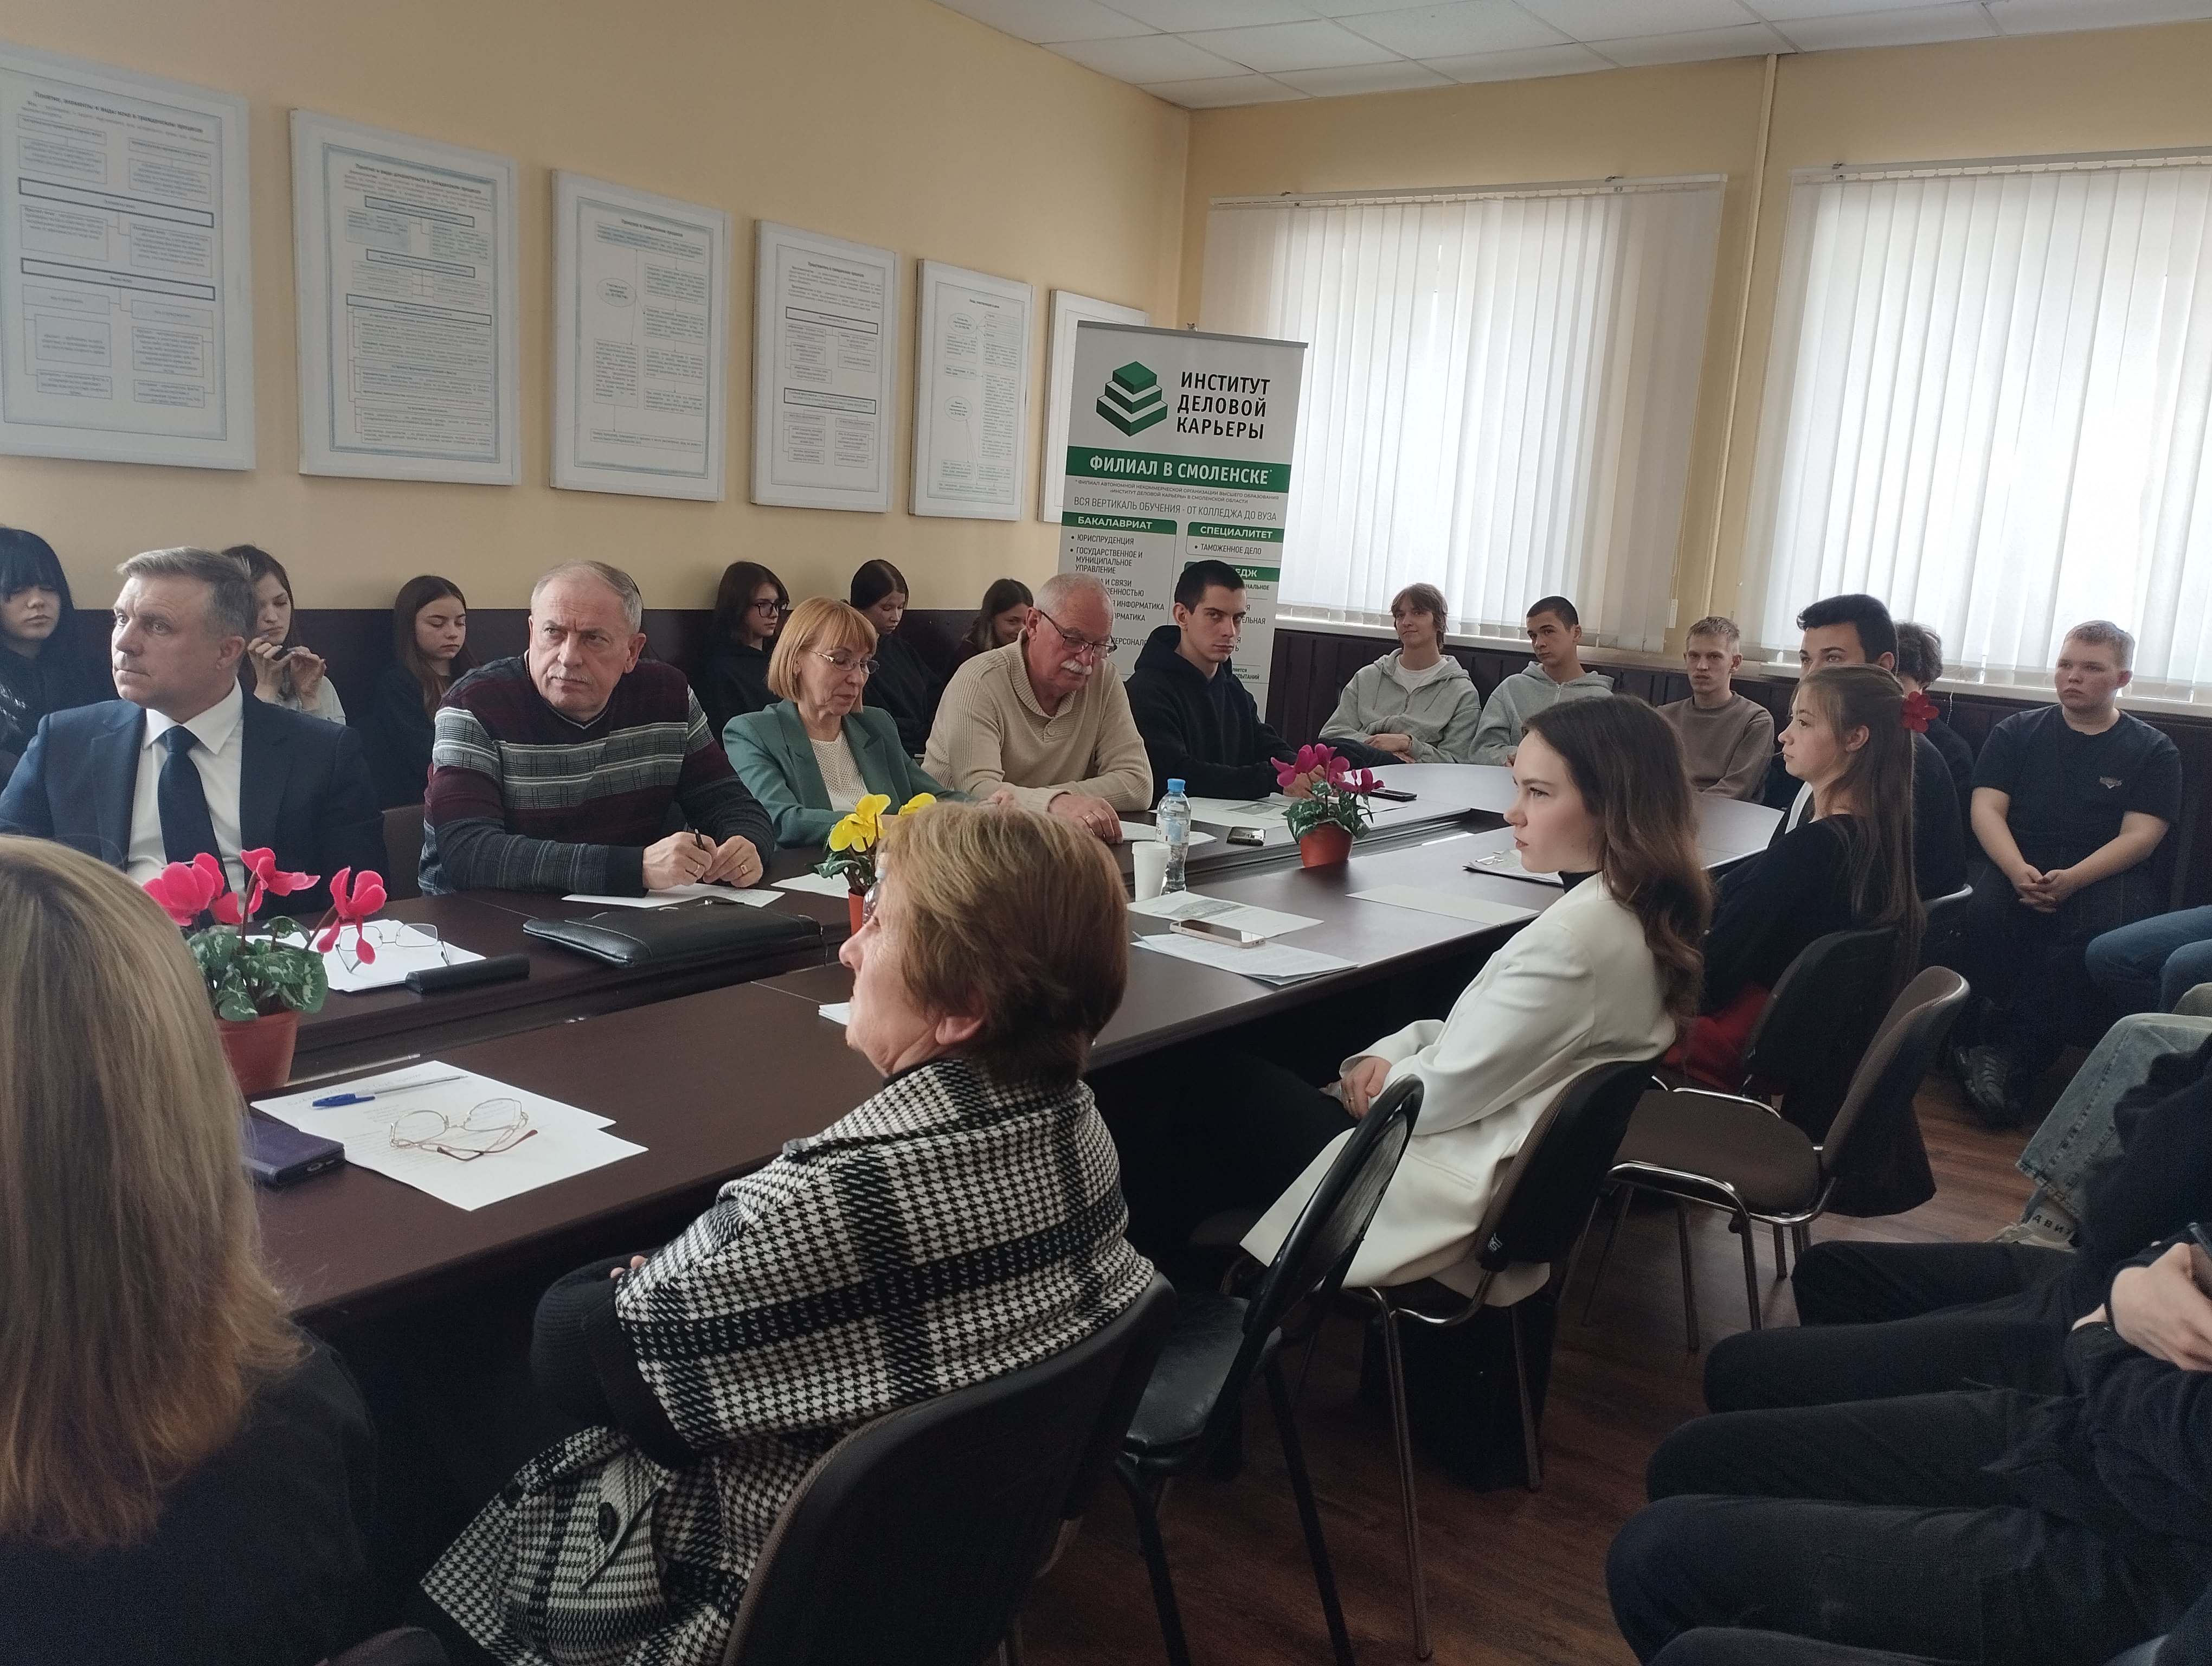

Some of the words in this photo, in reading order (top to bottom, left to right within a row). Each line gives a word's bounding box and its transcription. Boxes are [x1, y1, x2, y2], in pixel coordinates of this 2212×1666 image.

[1181, 371, 1271, 395] ИНСТИТУТ
[1177, 394, 1266, 417] ДЕЛОВОЙ
[1176, 417, 1264, 439] КАРЬЕРЫ
[1089, 455, 1158, 476] ФИЛИАЛ
[1163, 462, 1173, 476] В
[1074, 497, 1090, 507] ВСЯ
[1091, 498, 1137, 510] ВЕРТИКАЛЬ
[1140, 502, 1180, 514] ОБУЧЕНИЯ
[1187, 505, 1197, 514] ОТ
[1198, 507, 1242, 518] КОЛЛЕДЖА
[1244, 510, 1255, 520] ДО
[1257, 511, 1277, 521] ВУЗА
[1078, 516, 1153, 529] БАКАЛАВРИАТ
[1200, 526, 1273, 539] СПЕЦИАЛИТЕТ
[1077, 534, 1134, 545] ЮРИСПРУДЕНЦИЯ
[1076, 547, 1136, 558] ГОСУДАРСТВЕННОЕ
[1200, 543, 1243, 553] ТАМОЖЕННОЕ
[1244, 547, 1262, 555] ДЕЛО
[1076, 556, 1133, 566] МУНИЦИПАЛЬНОЕ
[1075, 565, 1116, 574] УПРАВЛЕНИЕ
[1117, 600, 1165, 611] ИНФОРМАТИКА
[1242, 616, 1266, 625] ЕЛЬНАЯ
